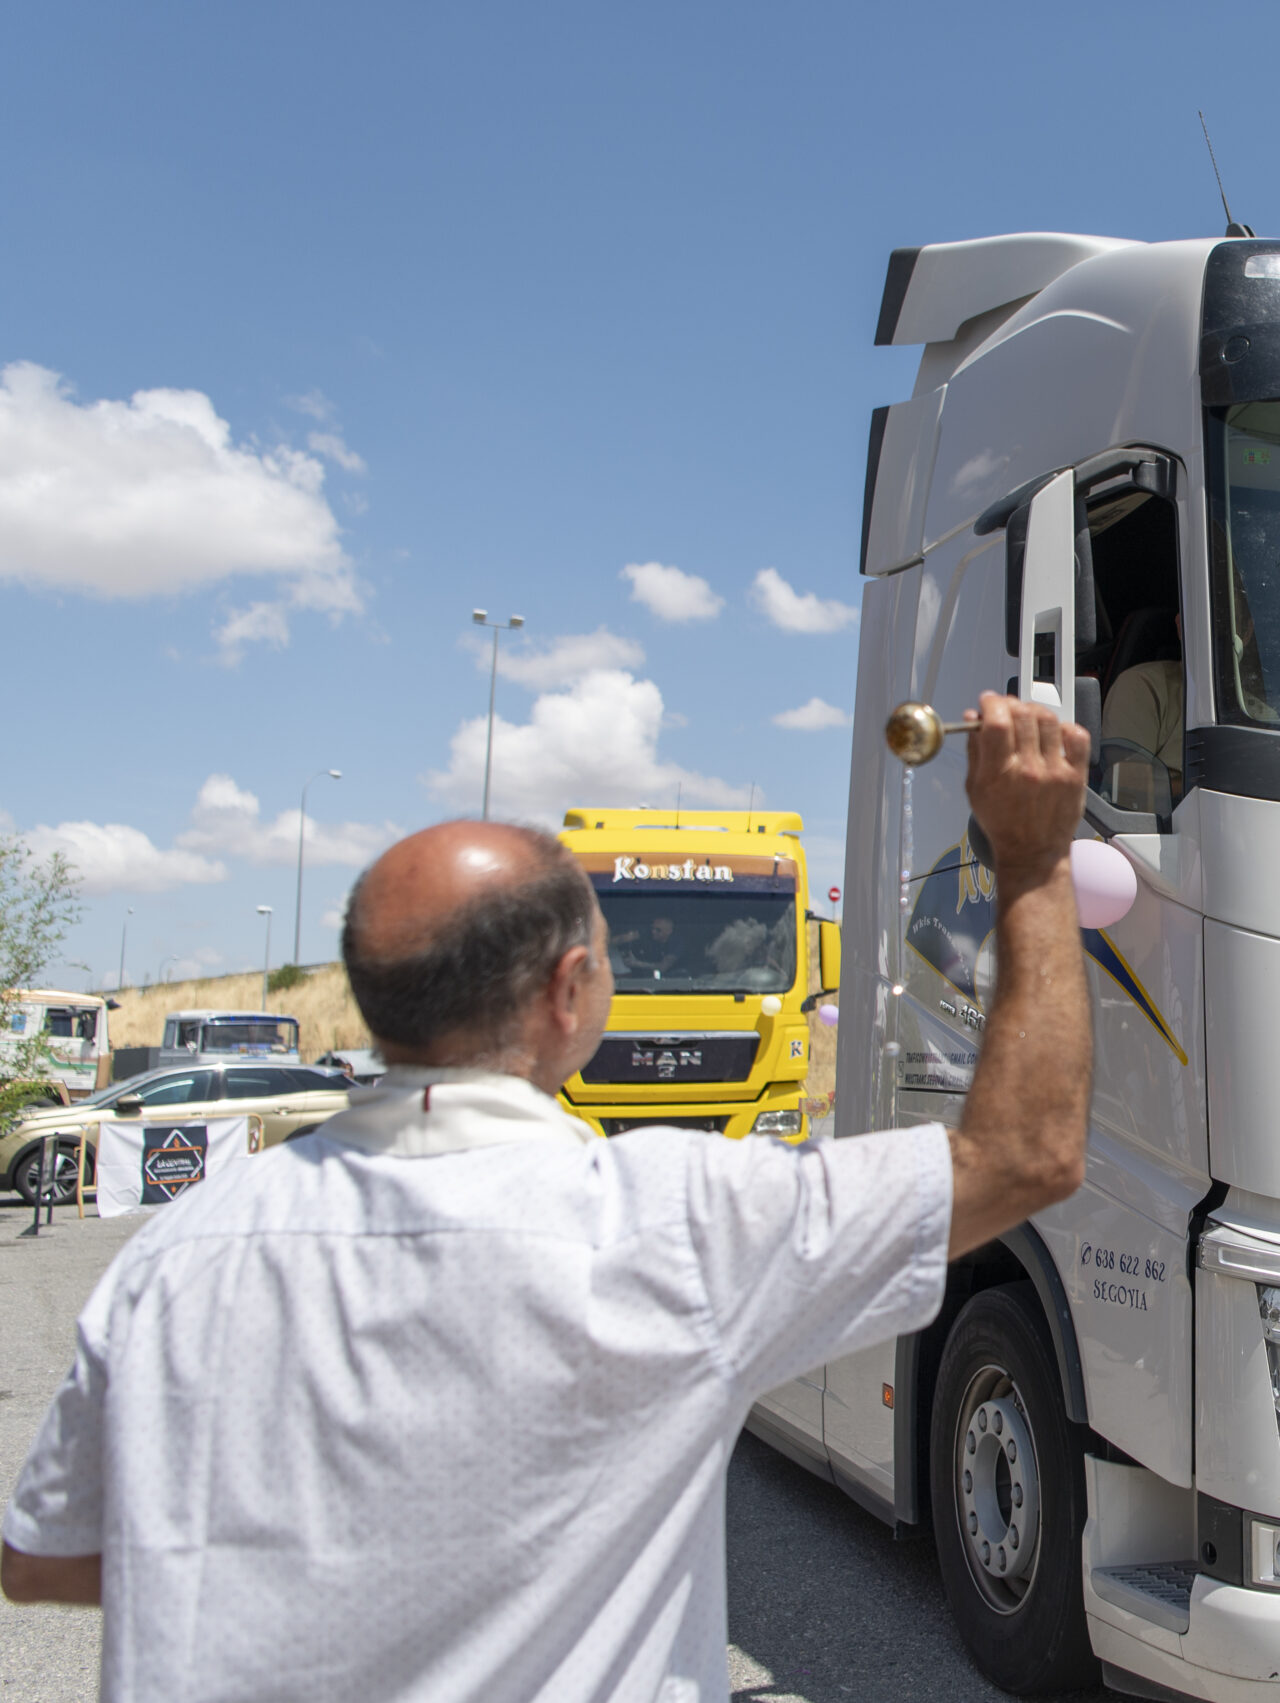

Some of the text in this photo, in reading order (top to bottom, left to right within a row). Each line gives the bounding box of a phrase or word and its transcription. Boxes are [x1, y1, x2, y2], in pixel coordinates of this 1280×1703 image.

[612, 855, 734, 882] Konstan
[632, 1052, 702, 1066] MAN
[1095, 1248, 1166, 1282] 638 622 862
